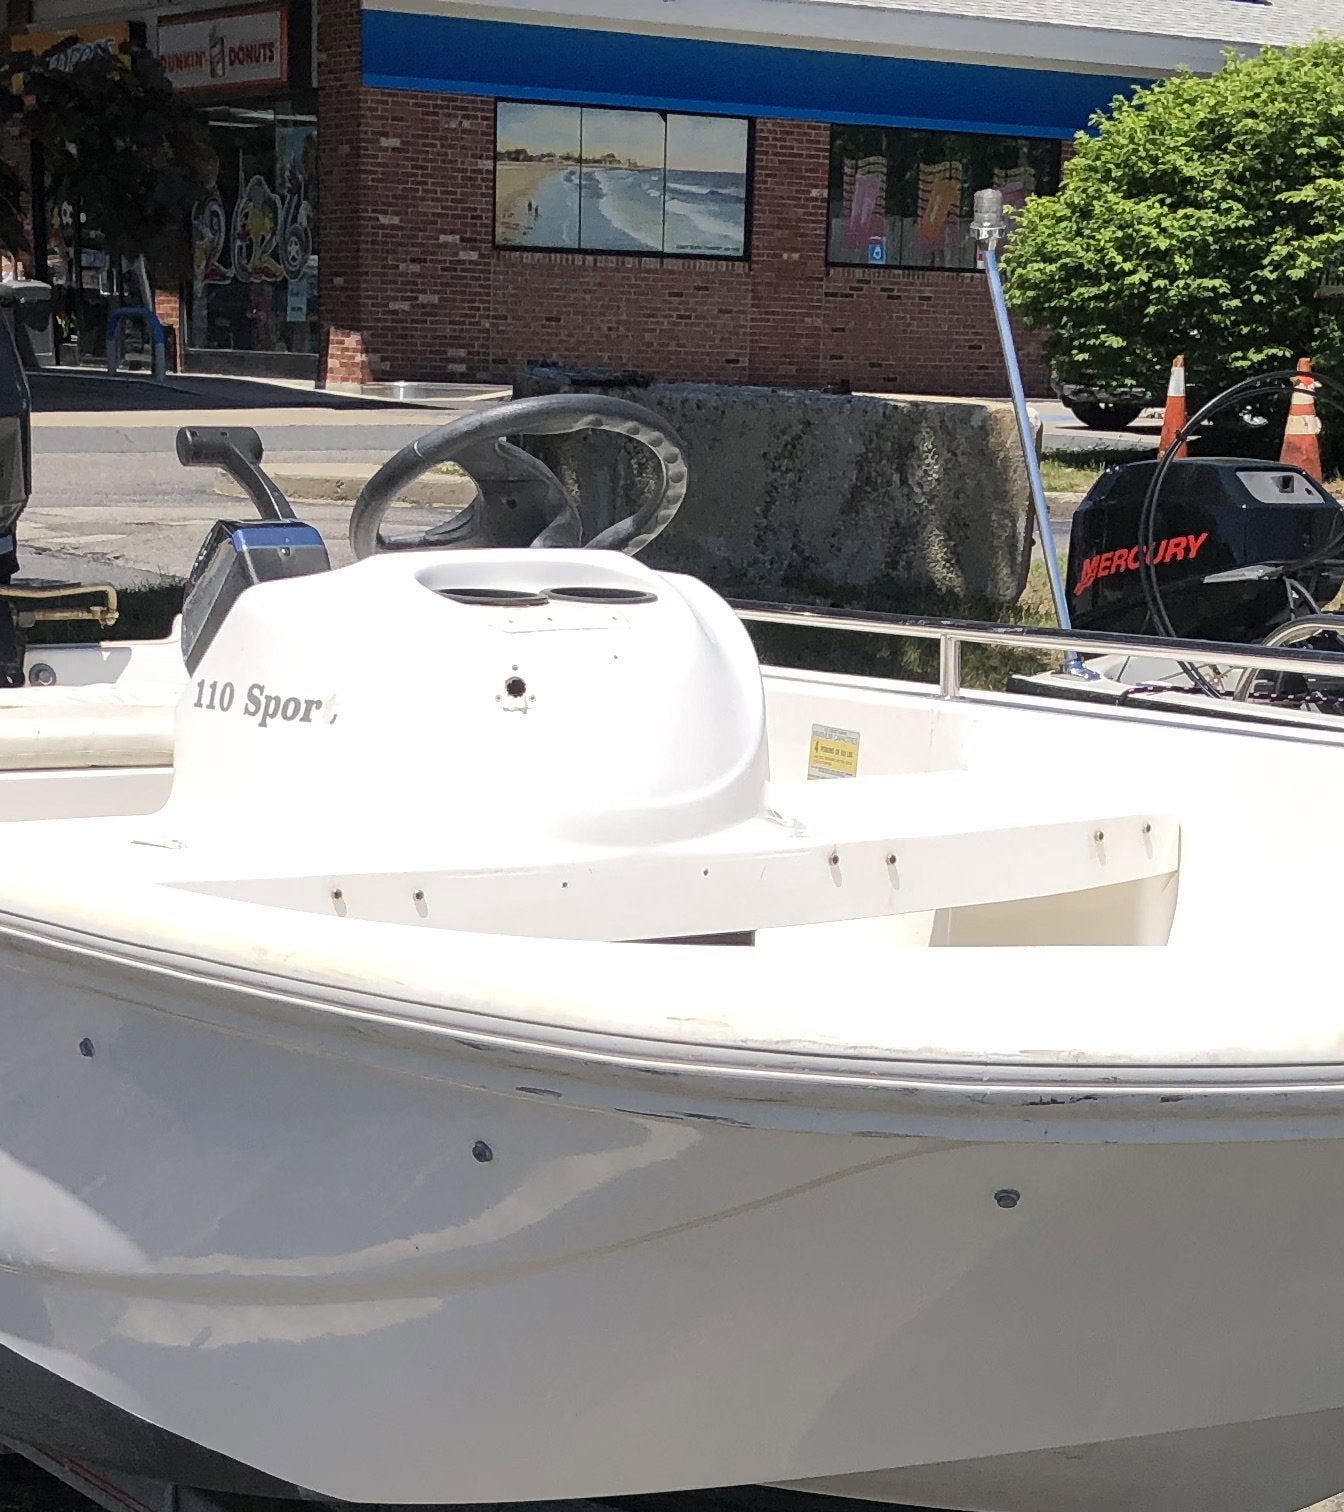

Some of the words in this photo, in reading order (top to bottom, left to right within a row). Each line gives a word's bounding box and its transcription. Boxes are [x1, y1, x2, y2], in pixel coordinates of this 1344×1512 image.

[228, 41, 276, 67] DONUTS
[1073, 532, 1209, 597] MERCURY
[194, 679, 235, 713] 110
